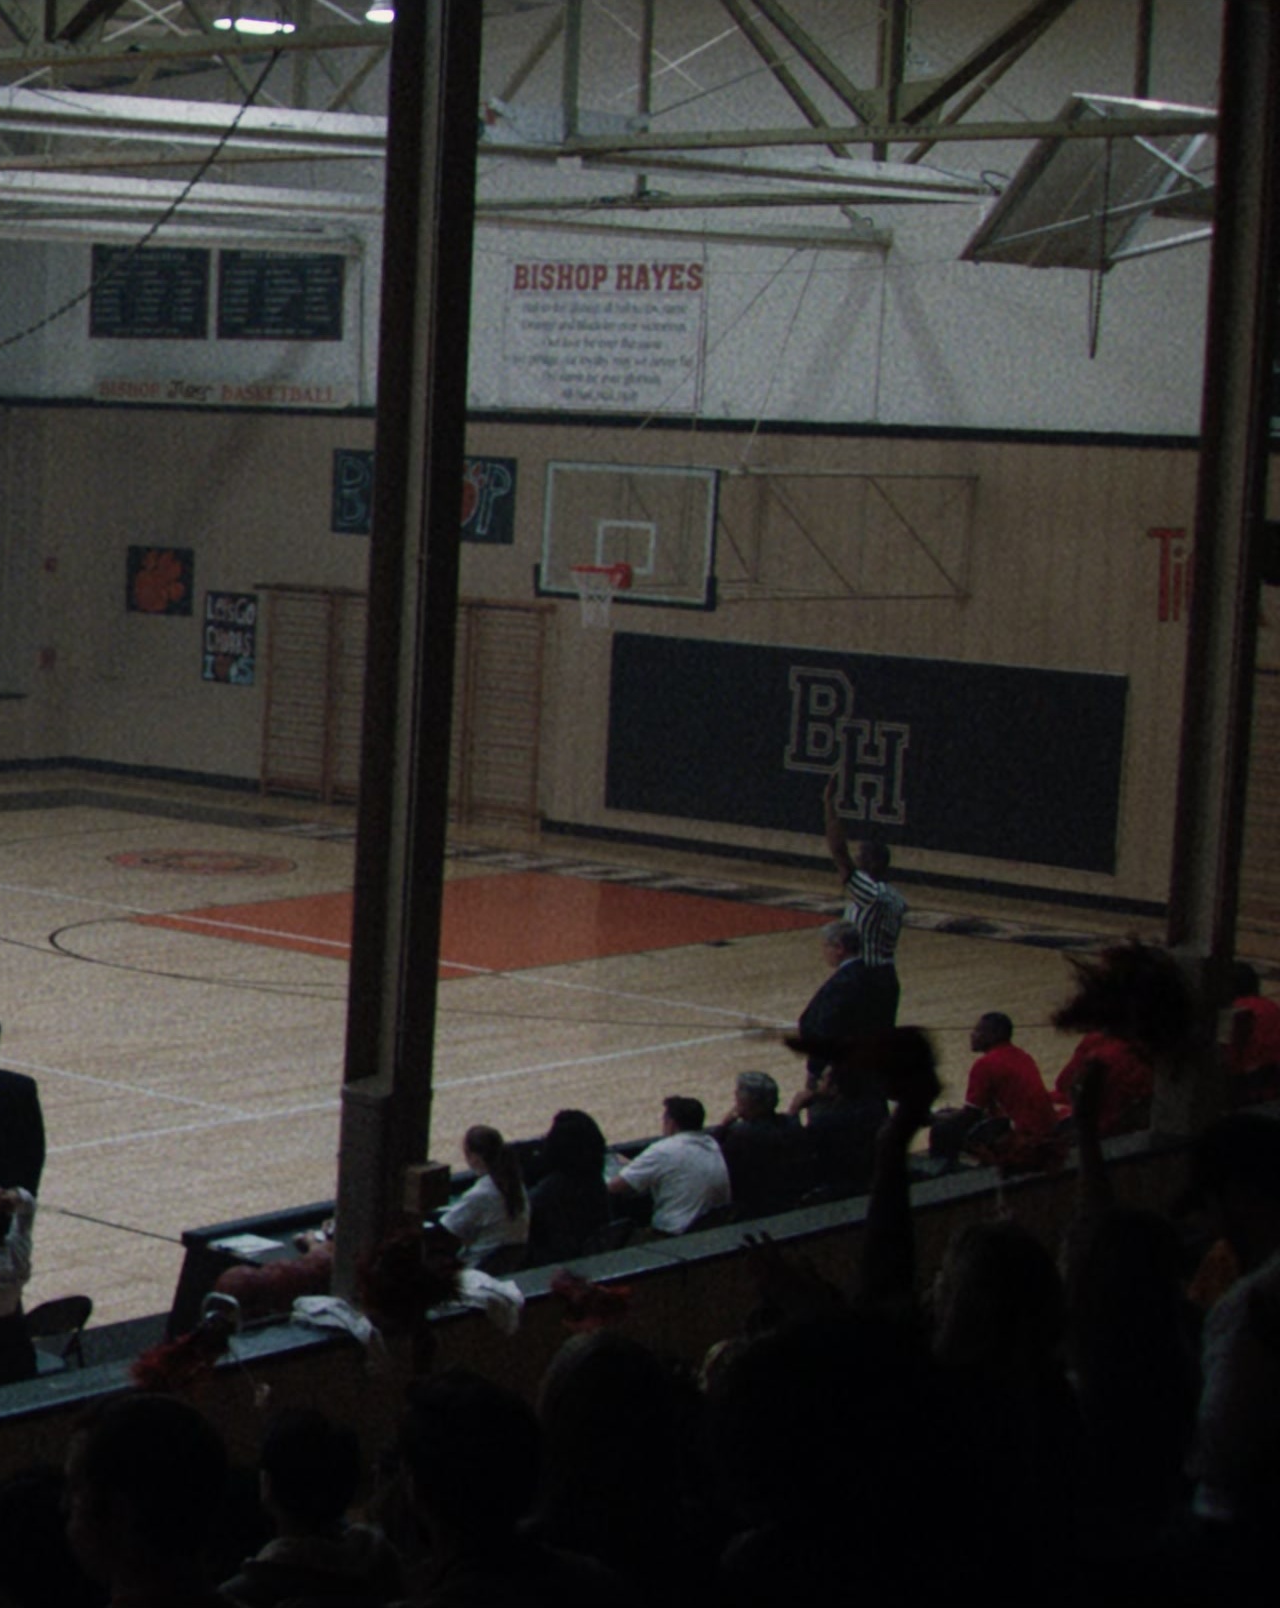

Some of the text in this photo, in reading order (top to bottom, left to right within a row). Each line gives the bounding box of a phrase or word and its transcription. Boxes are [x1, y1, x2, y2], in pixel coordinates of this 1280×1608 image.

[513, 264, 704, 291] BISHOP HAYES
[221, 385, 333, 402] BASKETBALL
[784, 665, 911, 825] BH
